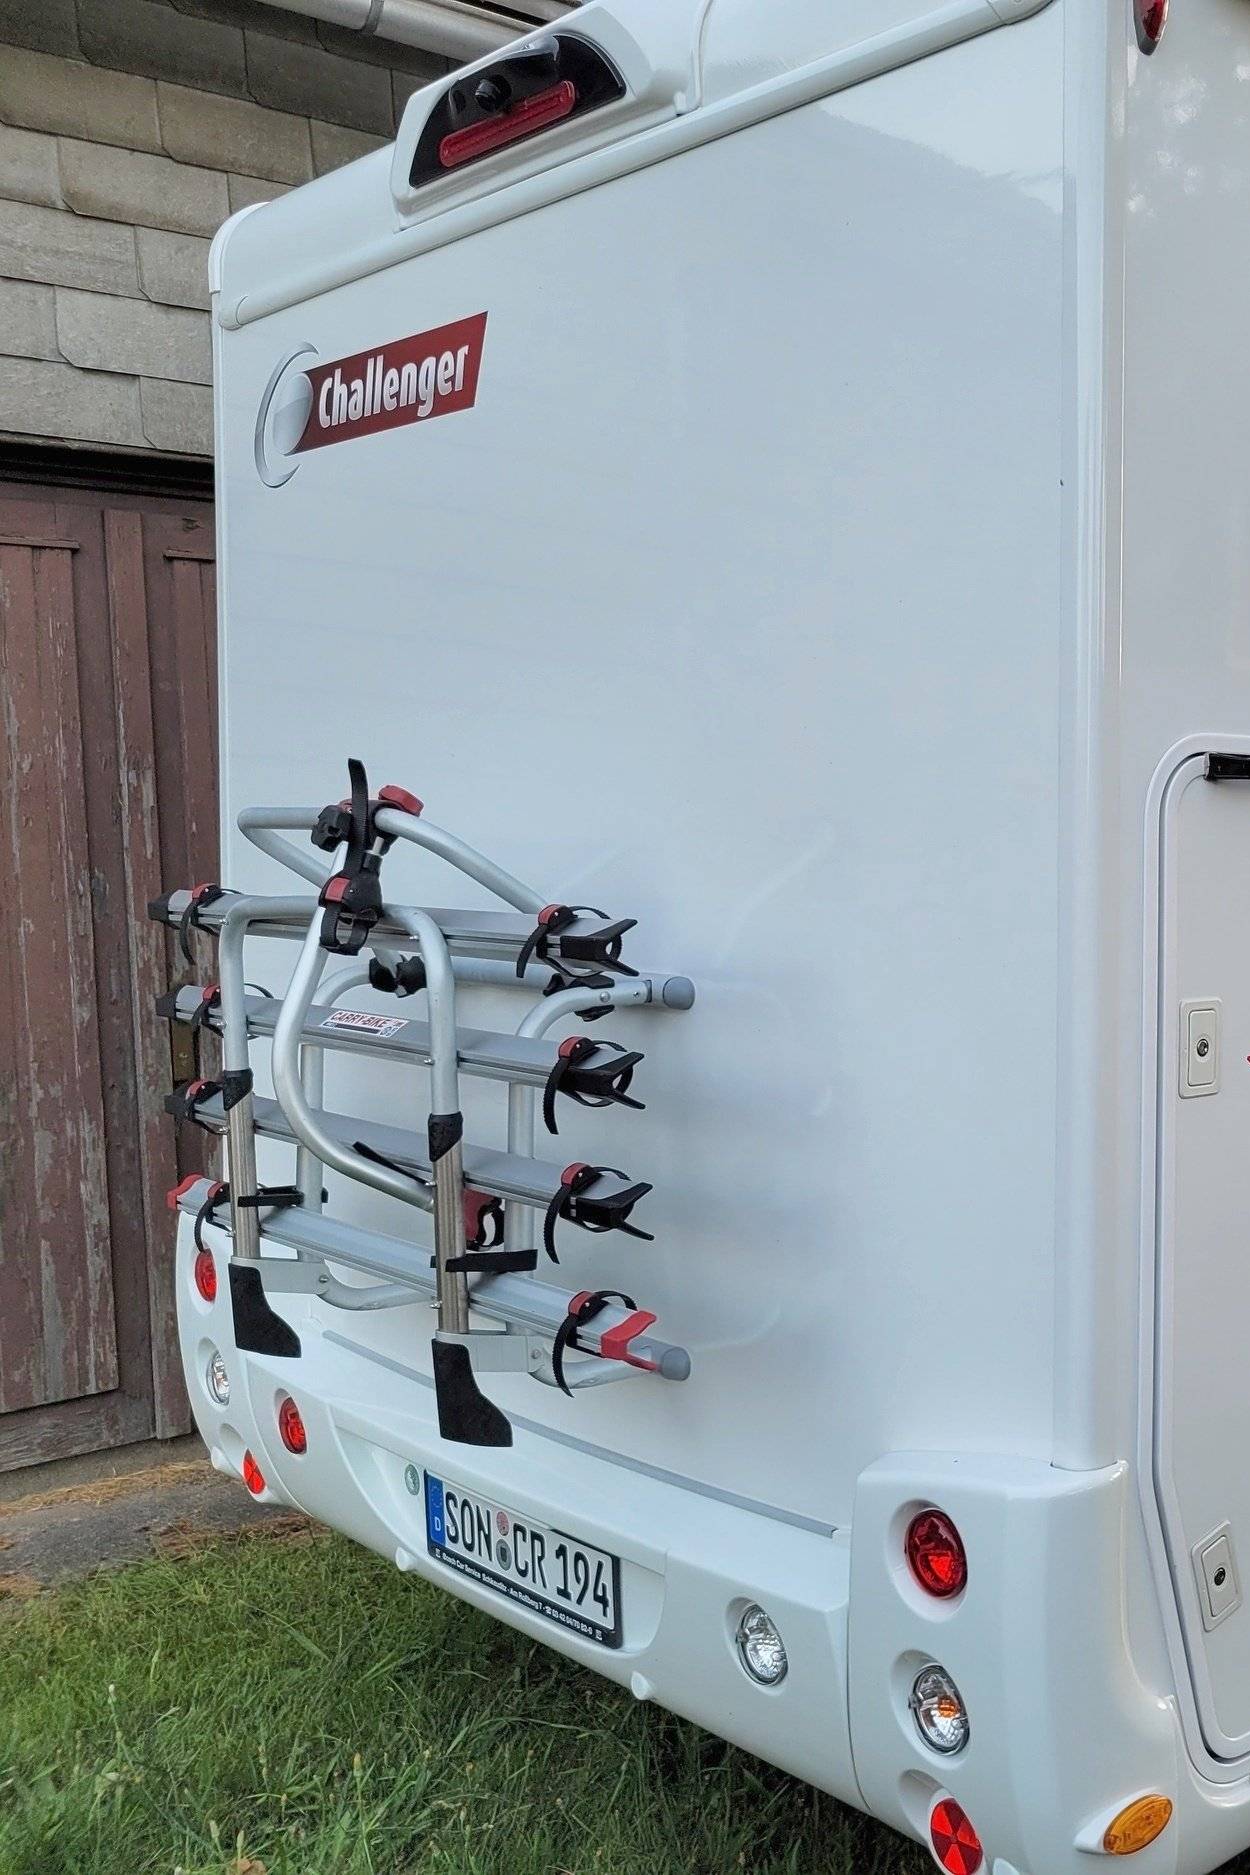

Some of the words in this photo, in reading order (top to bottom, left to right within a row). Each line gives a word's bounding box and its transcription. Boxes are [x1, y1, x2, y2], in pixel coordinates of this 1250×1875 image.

[318, 345, 469, 429] Challenger
[434, 1516, 441, 1532] D
[445, 1491, 494, 1562] SON
[512, 1522, 547, 1589] CR
[555, 1543, 609, 1618] 194
